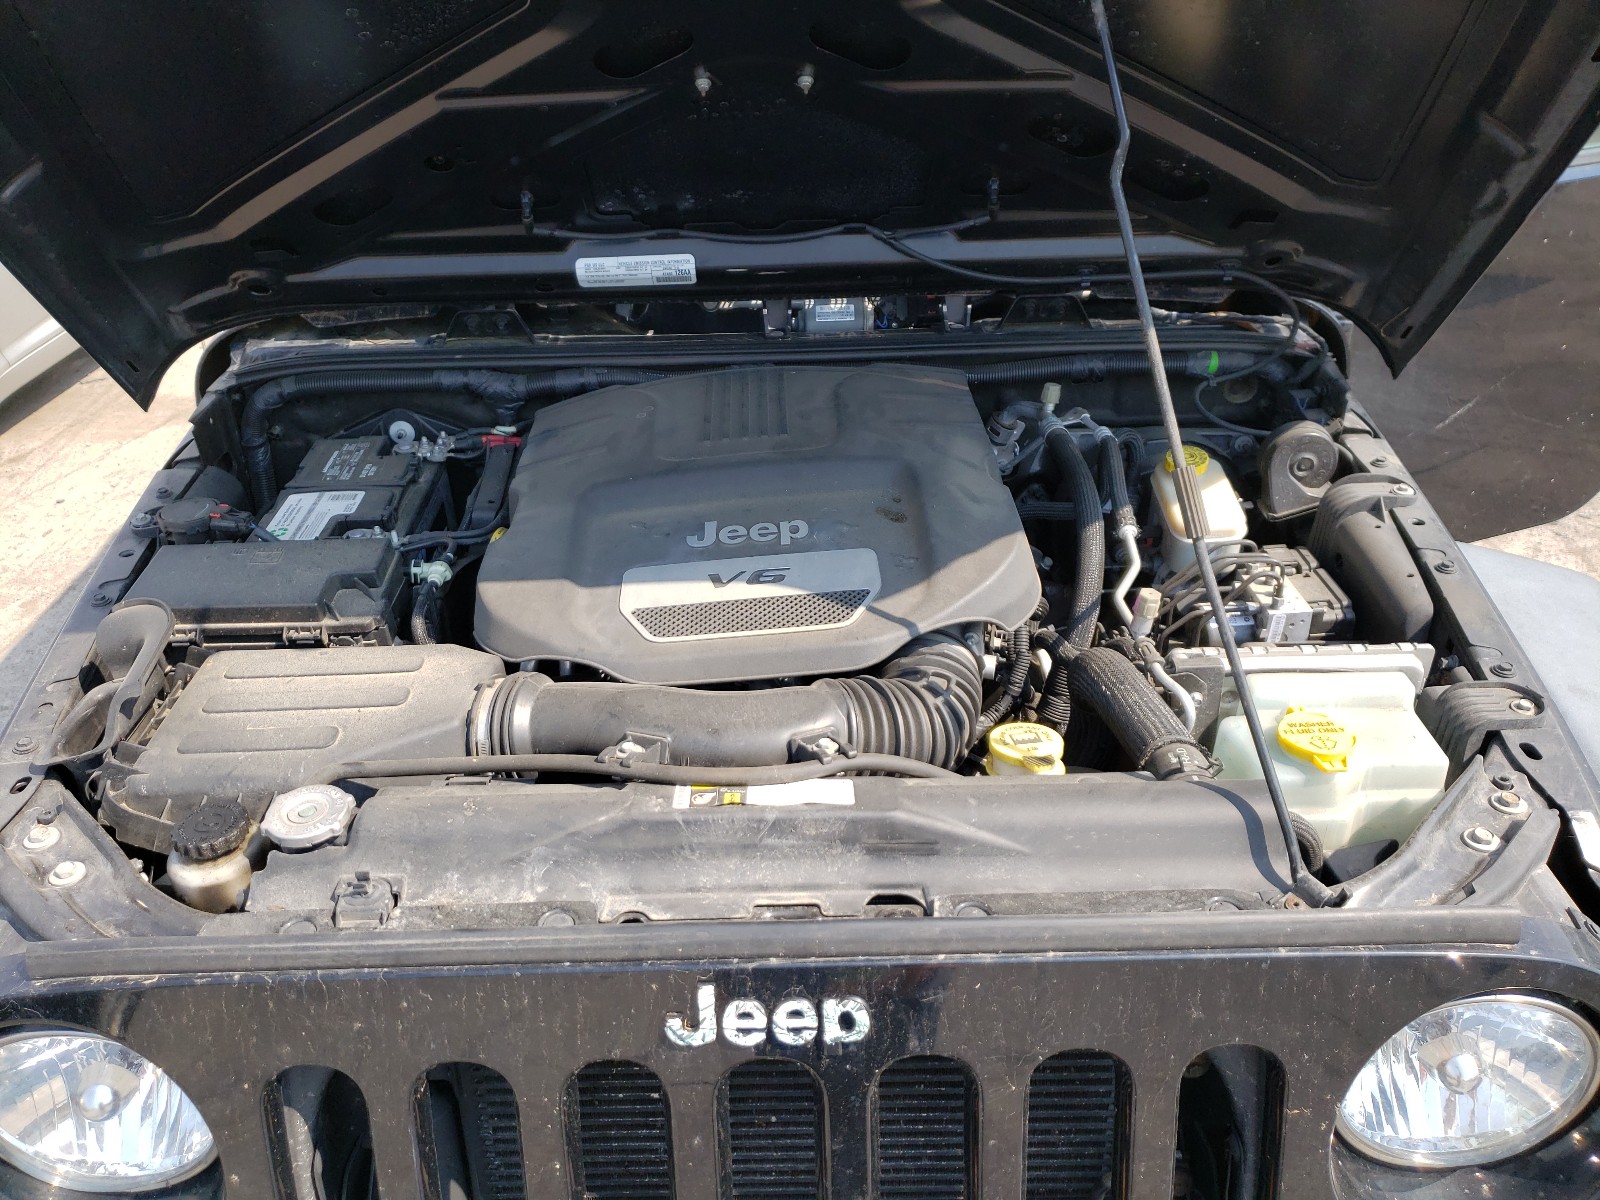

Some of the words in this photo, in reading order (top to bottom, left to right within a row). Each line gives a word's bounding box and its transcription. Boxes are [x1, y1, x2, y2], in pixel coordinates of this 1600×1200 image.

[686, 519, 809, 548] Jeep
[707, 566, 791, 589] V6
[664, 982, 871, 1052] Jeep
